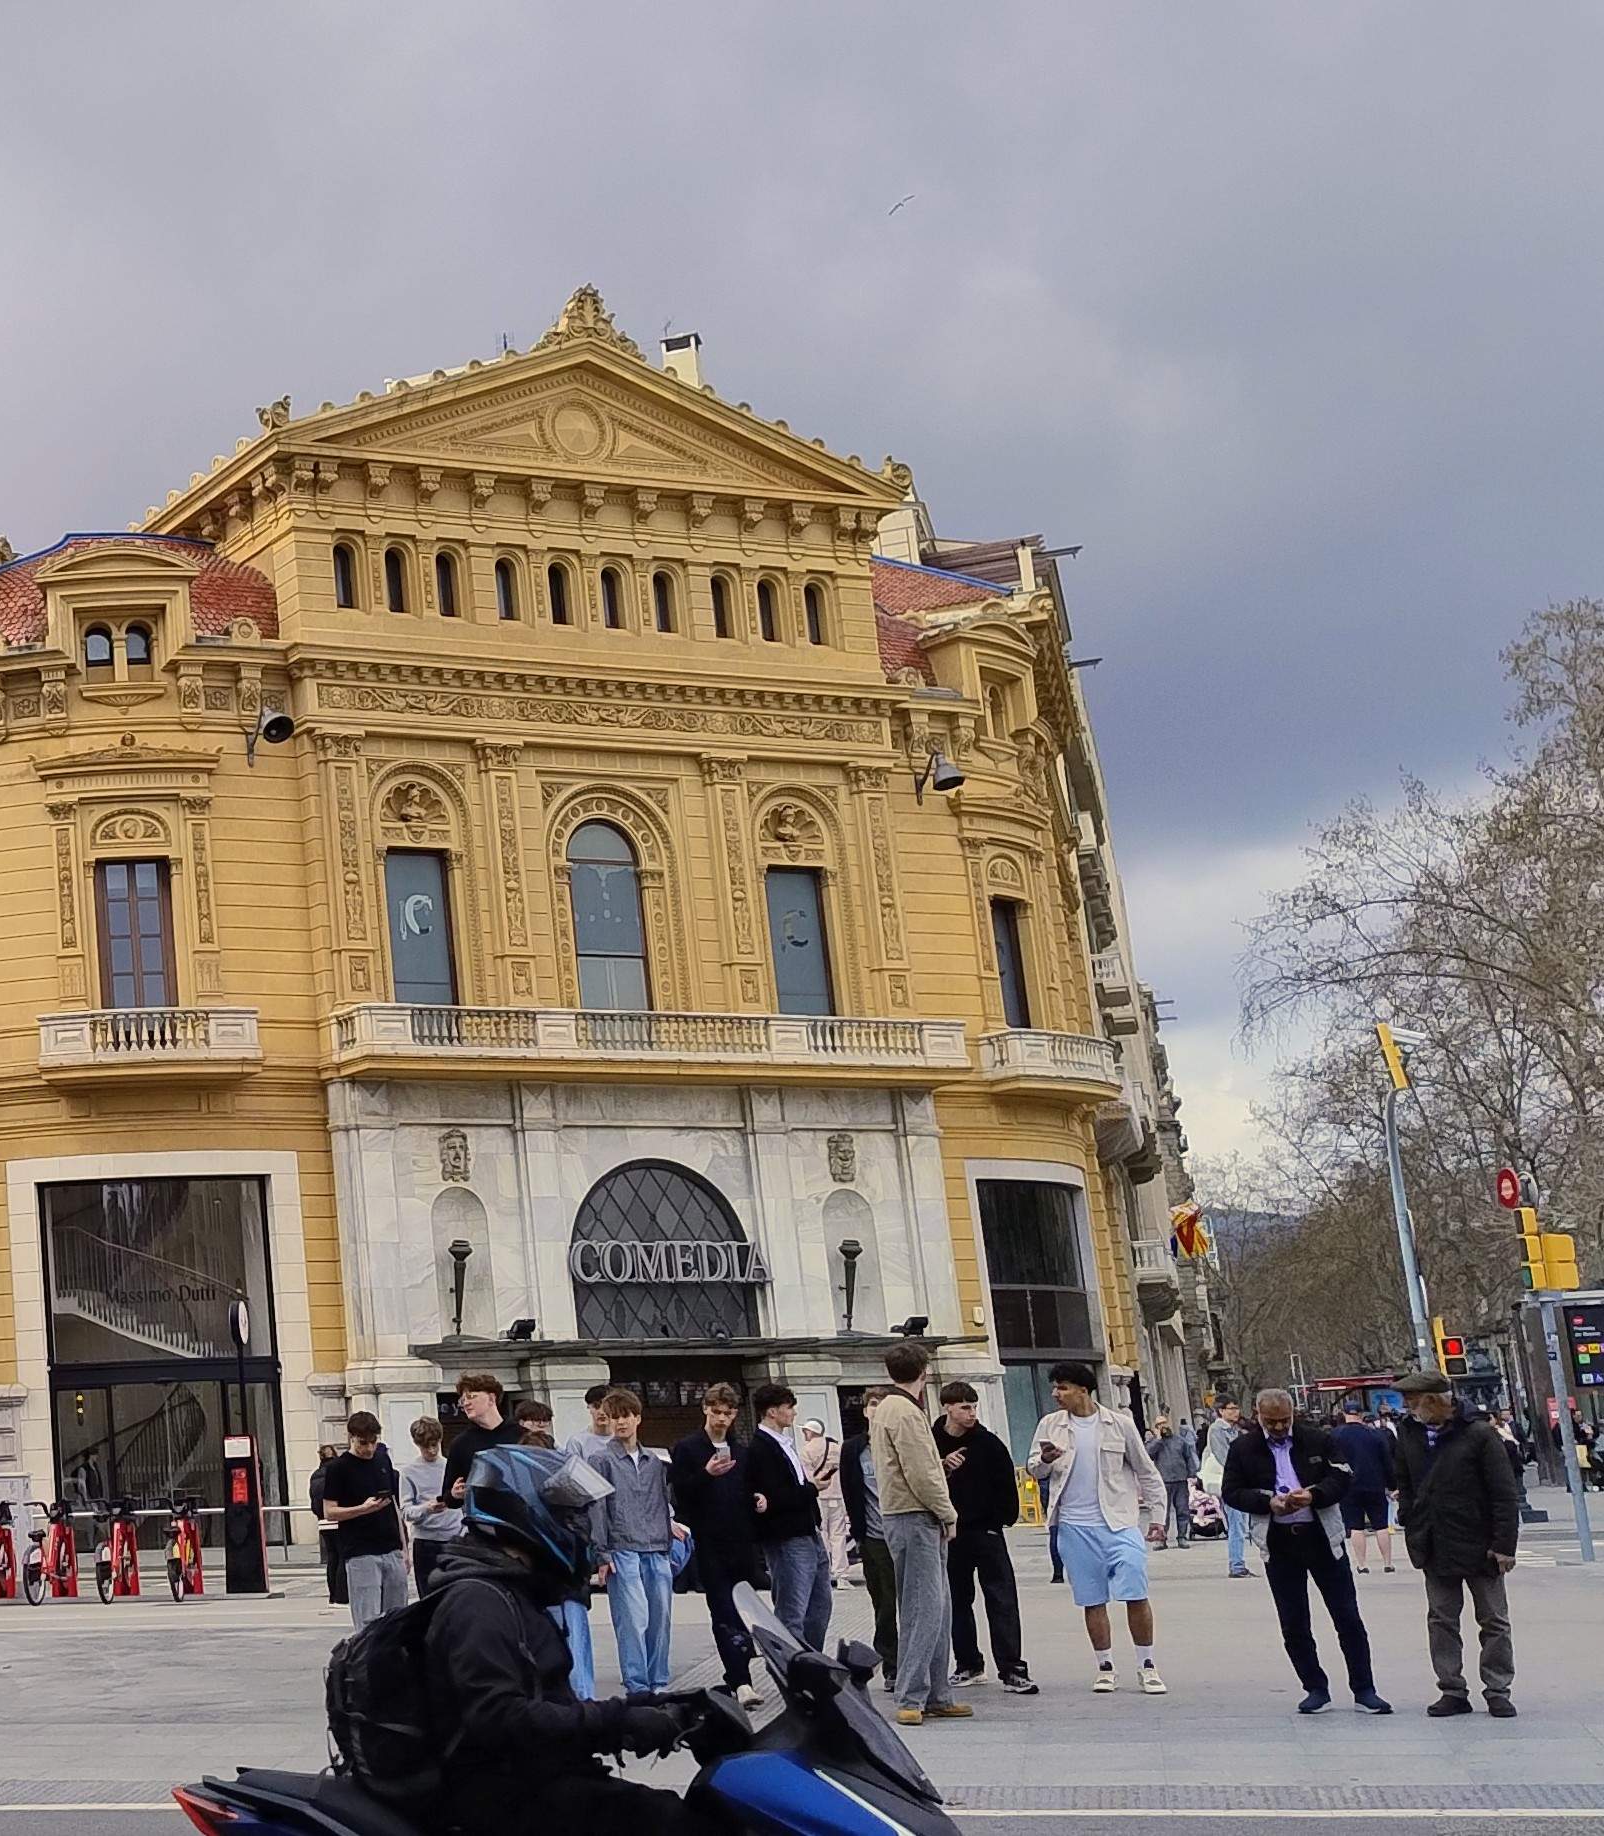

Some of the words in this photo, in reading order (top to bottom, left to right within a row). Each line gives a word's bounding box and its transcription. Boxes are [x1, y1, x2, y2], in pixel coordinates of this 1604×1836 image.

[569, 1239, 775, 1284] COMEDIA
[105, 1286, 172, 1304] Massimo
[178, 1284, 216, 1302] Dutti
